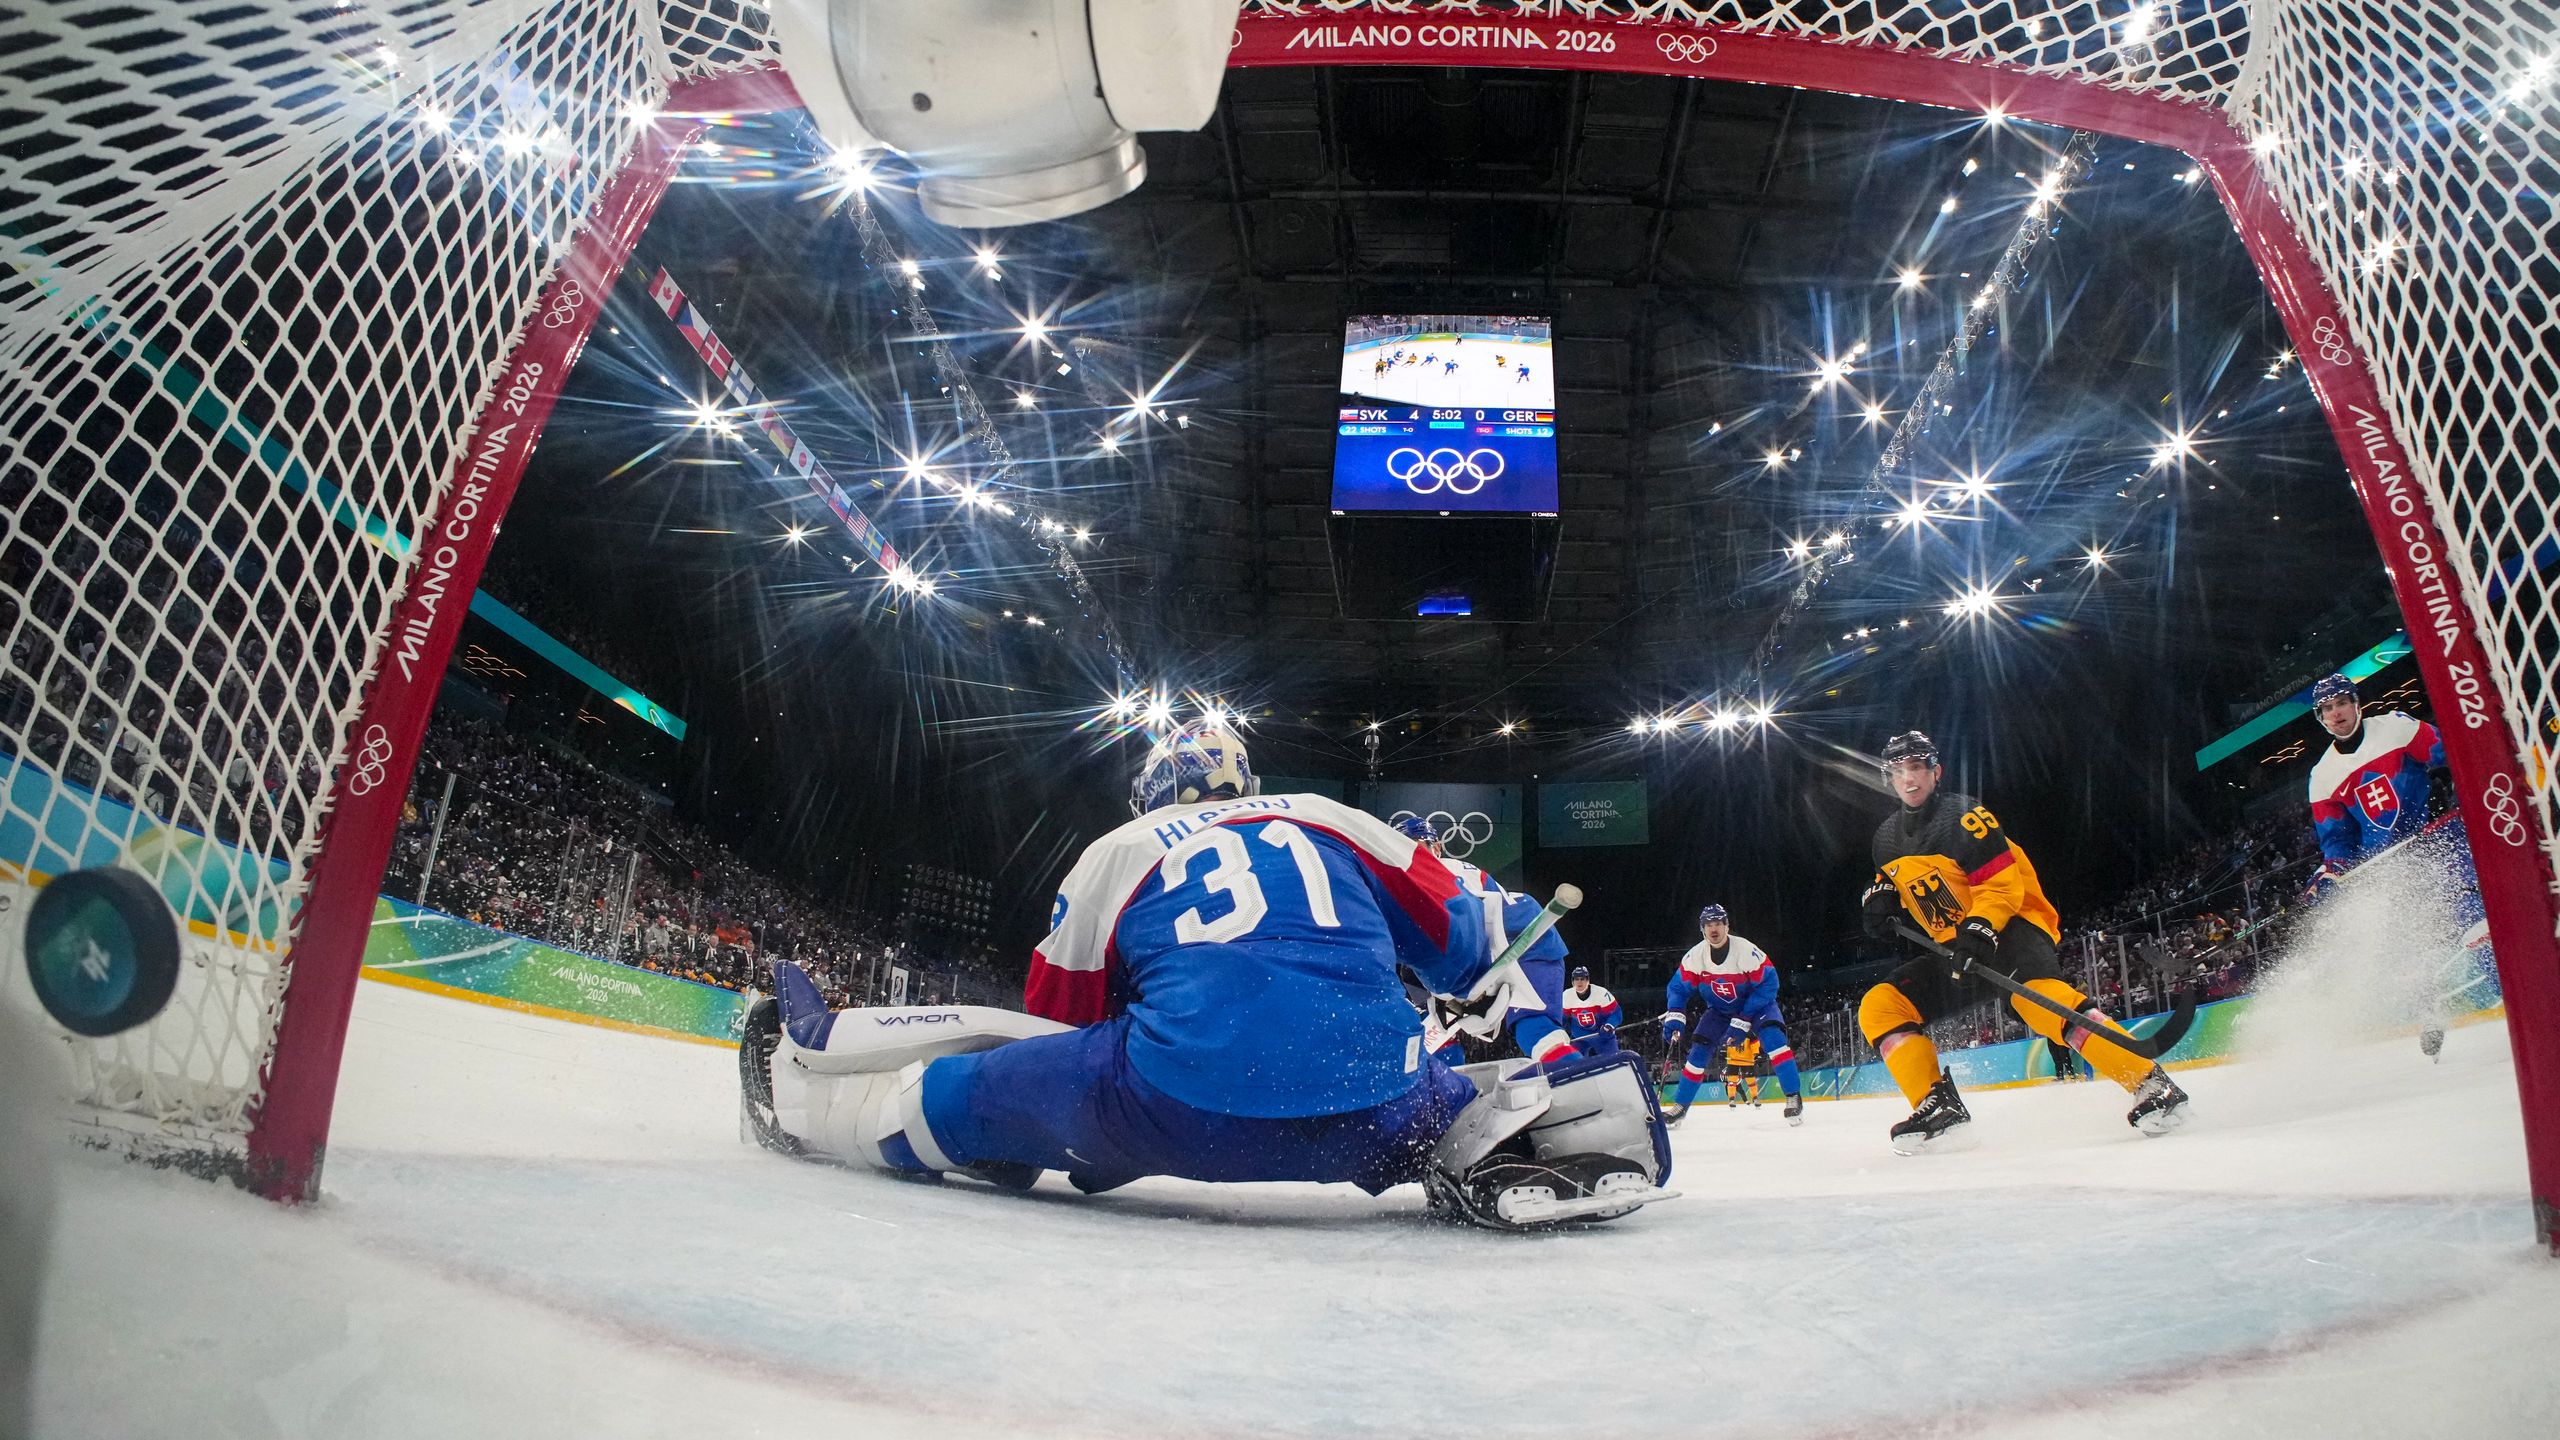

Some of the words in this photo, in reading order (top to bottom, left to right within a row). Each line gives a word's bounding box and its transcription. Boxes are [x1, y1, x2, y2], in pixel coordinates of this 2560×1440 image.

[1285, 25, 1411, 49] MILANO
[1418, 25, 1549, 49] CORTINA
[1555, 30, 1616, 53] 2026
[1359, 409, 1388, 421] SVK
[1409, 410, 1419, 420] 4
[1432, 409, 1462, 420] 5:02
[1475, 410, 1485, 421] 0
[1503, 410, 1534, 422] GER
[397, 546, 458, 682] MILANO
[446, 422, 518, 541] CORTINA
[503, 361, 543, 416] 2026
[2348, 404, 2414, 517] MILANO
[2401, 521, 2460, 658] CORTINA
[2448, 660, 2490, 729] 2026
[1564, 800, 1612, 810] MILANO
[1572, 810, 1622, 819] CORTINA
[1582, 820, 1605, 829] 2026
[1961, 806, 1999, 839] 95
[1160, 819, 1341, 944] 31
[552, 967, 599, 986] MILANO
[600, 977, 642, 997] CORTINA
[586, 988, 608, 1002] 2026
[874, 1014, 964, 1026] VAPOR
